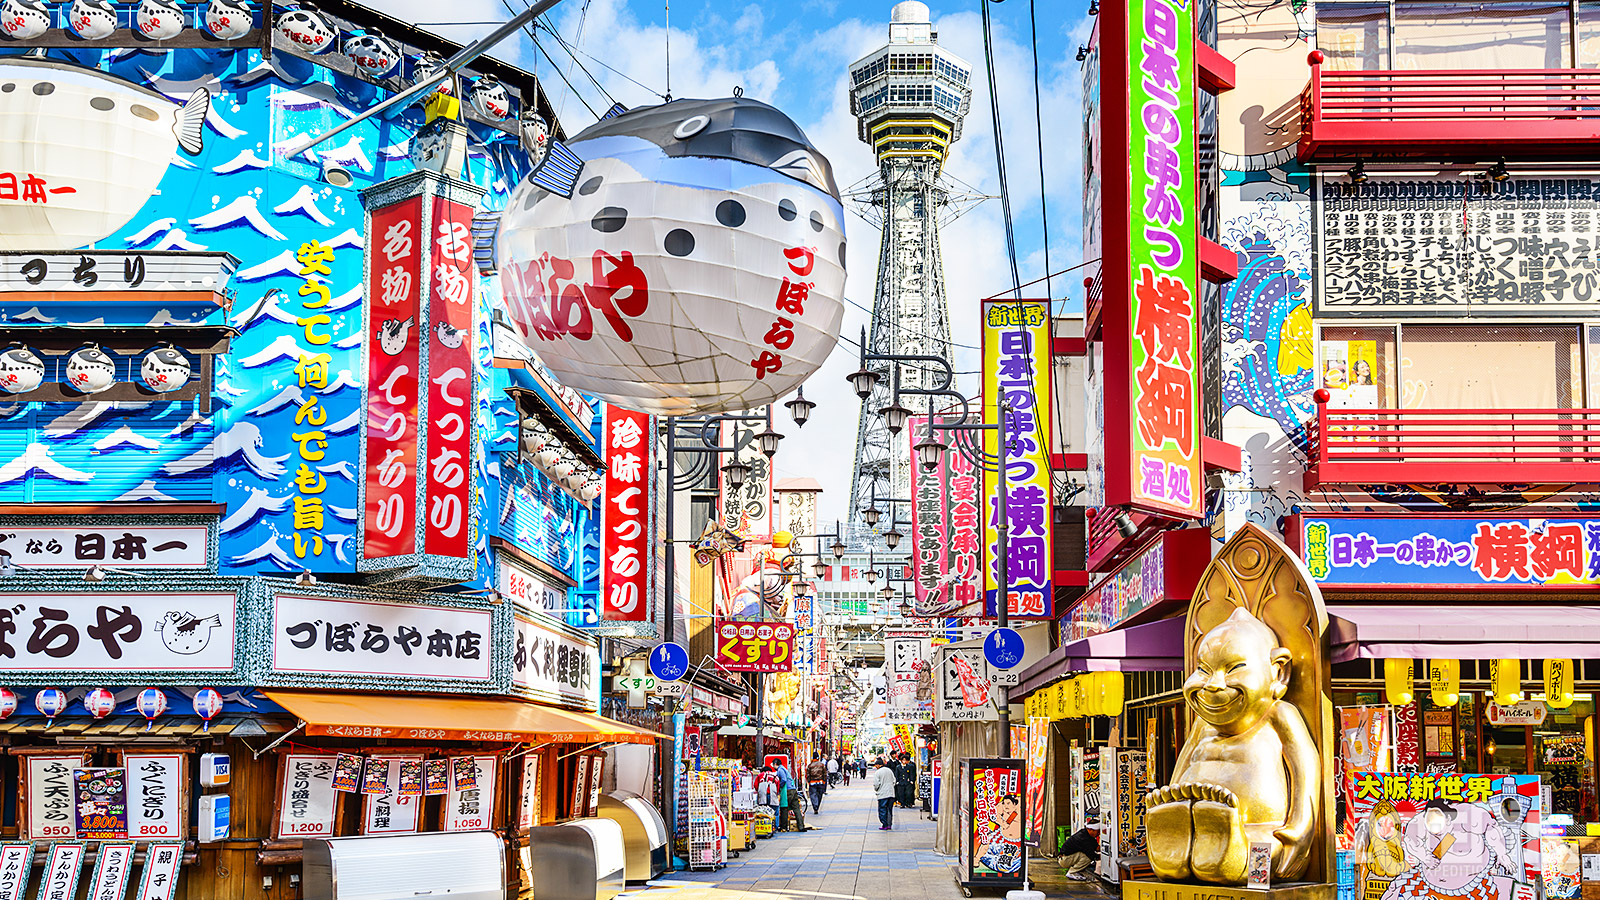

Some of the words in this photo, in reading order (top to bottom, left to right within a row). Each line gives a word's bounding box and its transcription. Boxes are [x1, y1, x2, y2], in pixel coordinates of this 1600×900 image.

[1141, 1, 1183, 267] 日本一の串かつ
[382, 220, 412, 306] 名物
[435, 219, 470, 305] 名物
[1493, 237, 1520, 302] つくね
[1517, 235, 1545, 304] 味噌豚
[1544, 238, 1572, 302] 穴子
[1570, 237, 1597, 301] えび
[751, 246, 819, 380] づぼらや
[1136, 268, 1192, 457] 横綱
[292, 239, 335, 559] 安うて何んでも旨い
[744, 457, 768, 519] 串かつ
[1142, 459, 1190, 504] 酒処
[1308, 524, 1328, 578] 新世界
[1333, 536, 1471, 565] 日本一の串かつ
[1474, 524, 1583, 578] 横綱
[286, 619, 482, 660] づぼらや本店
[721, 638, 789, 664] くすり
[619, 678, 655, 690] くすり
[1499, 709, 1533, 718] 角ハイボール
[43, 762, 70, 821] ふぐ天ぷら
[140, 761, 167, 820] ふぐにぎり
[216, 765, 228, 775] VISA
[290, 761, 313, 818] にぎり盛合せ
[313, 761, 333, 780] ふぐ
[1357, 775, 1494, 803] 大阪新世界
[43, 826, 71, 836] 950
[82, 816, 118, 829] 3,800
[139, 825, 168, 835] 800
[151, 850, 173, 900] 親子
